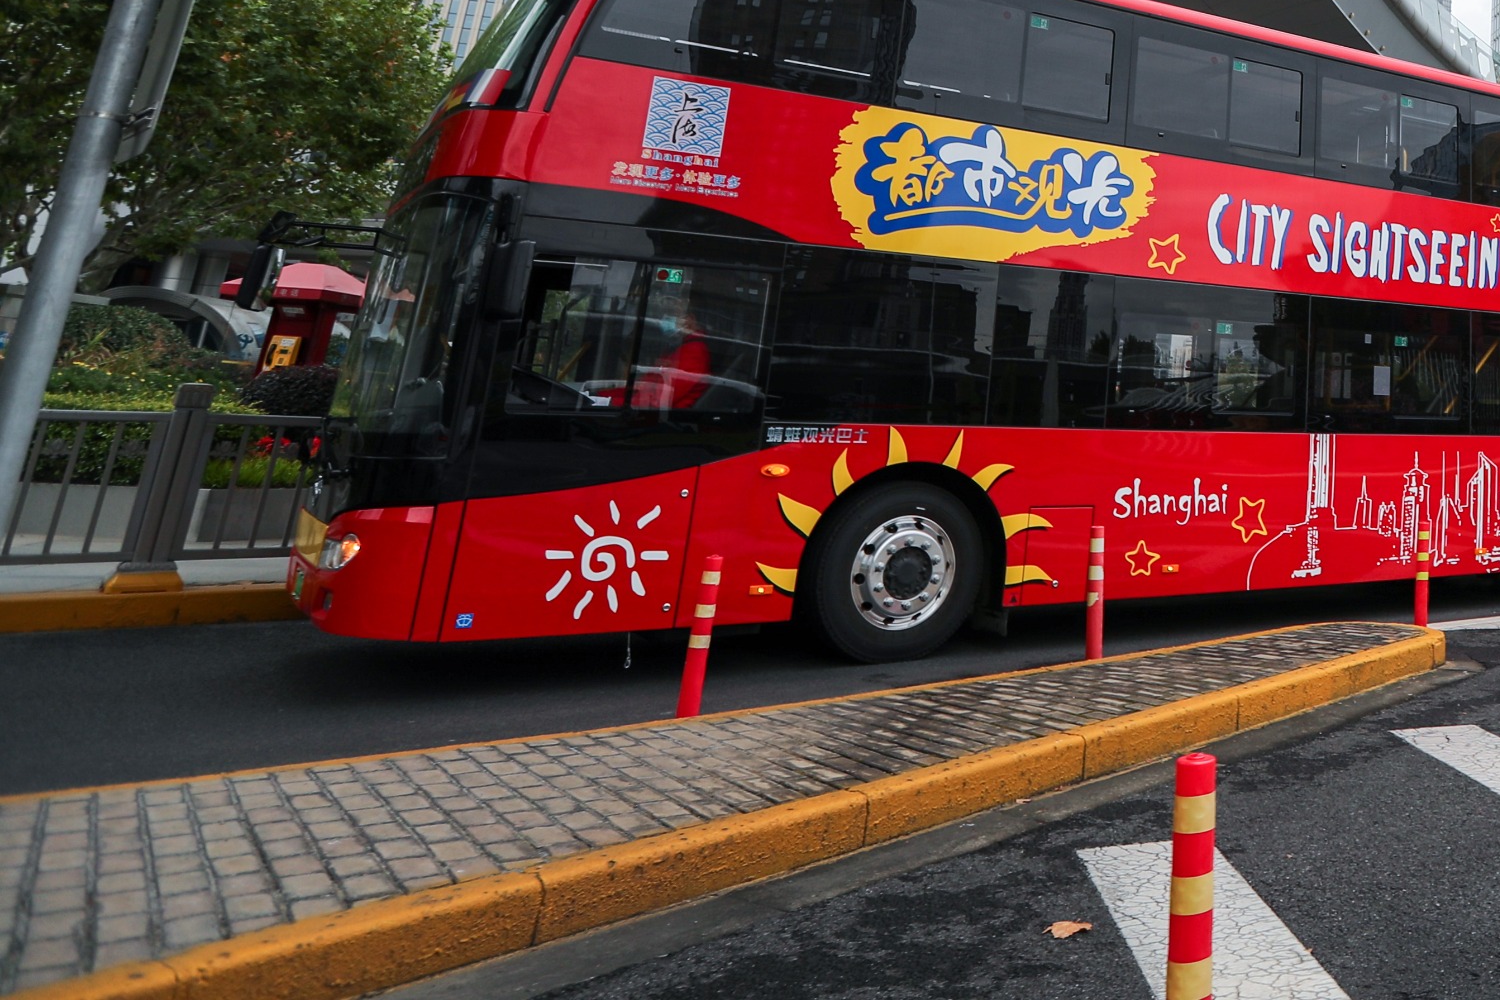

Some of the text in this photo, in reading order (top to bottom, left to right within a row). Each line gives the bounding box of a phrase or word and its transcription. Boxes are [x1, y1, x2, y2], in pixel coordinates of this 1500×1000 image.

[673, 92, 704, 144] 上海
[641, 148, 720, 168] Shanghai
[870, 127, 1131, 226] 都市观光
[1207, 193, 1294, 270] CITY
[765, 426, 870, 444] 蜻蜓观光巴士
[1113, 477, 1229, 526] Shanghai
